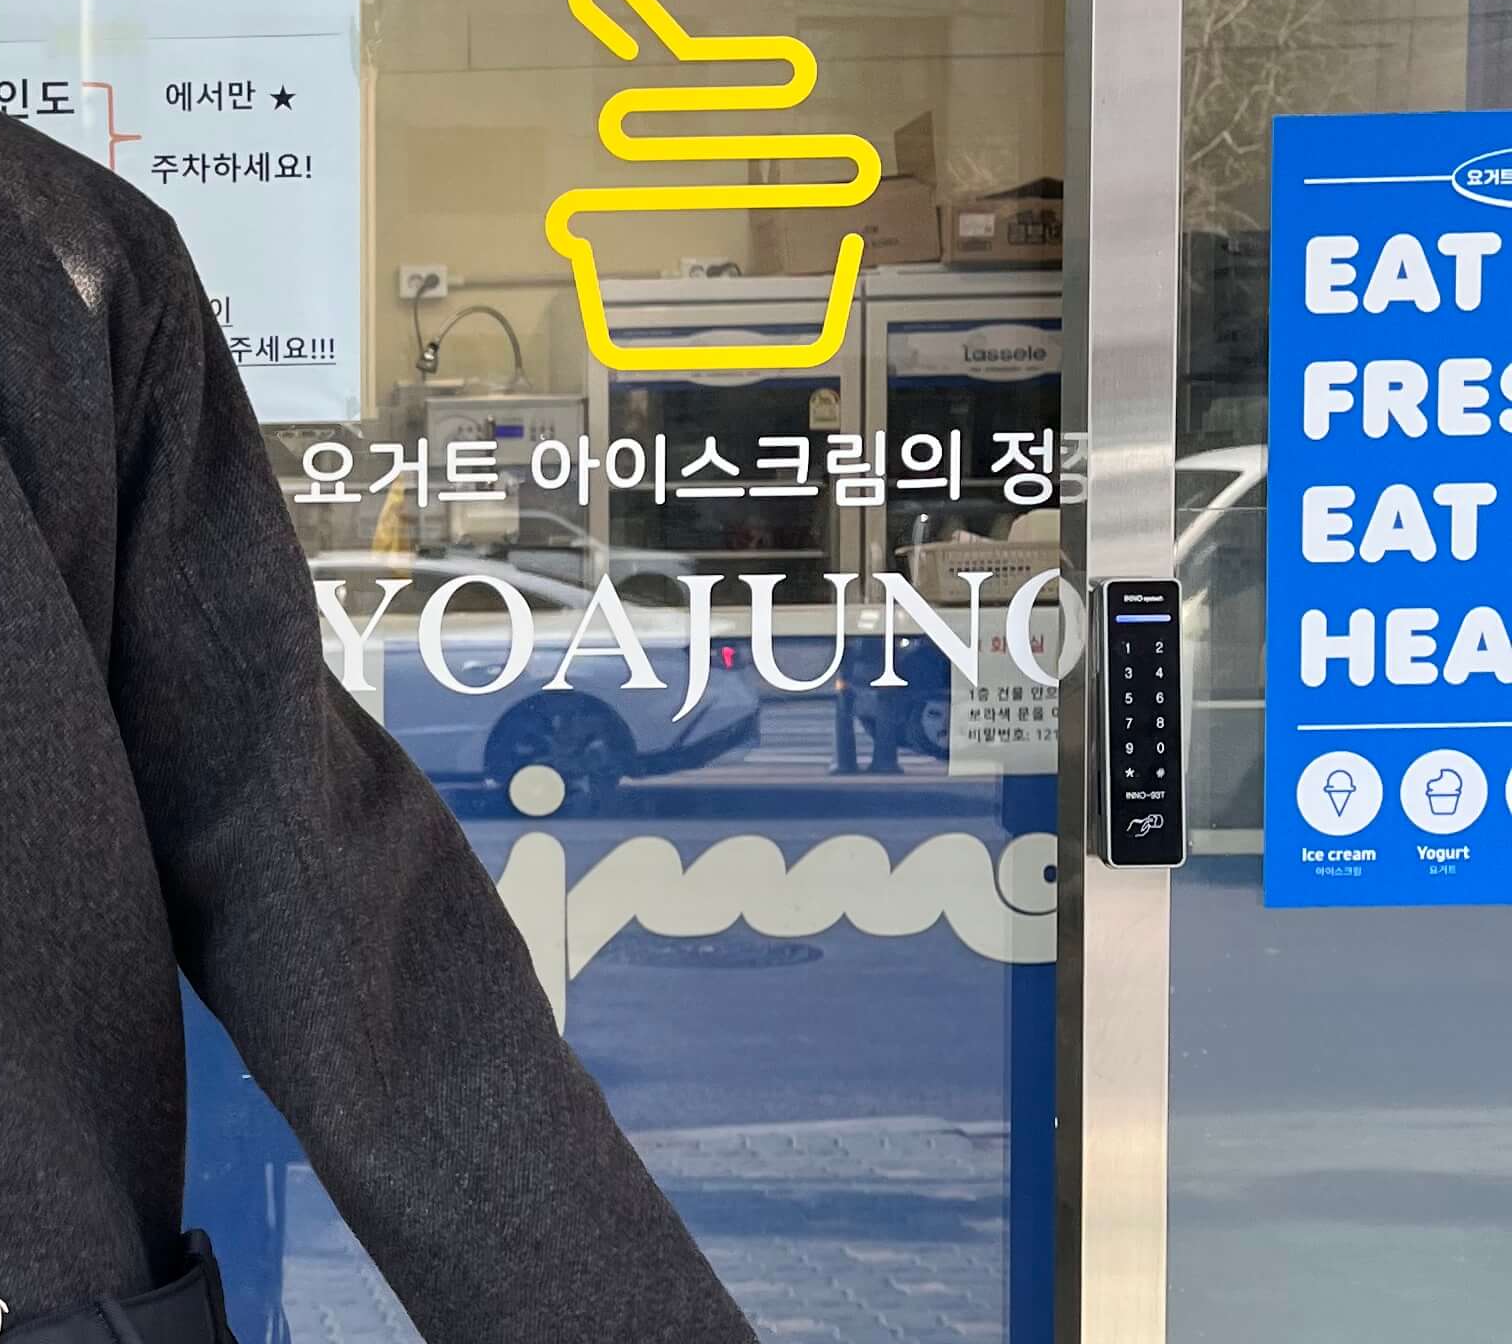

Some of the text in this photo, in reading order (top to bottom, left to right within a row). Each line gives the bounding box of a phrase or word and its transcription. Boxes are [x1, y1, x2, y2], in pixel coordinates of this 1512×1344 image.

[165, 80, 257, 112] 에서만
[150, 151, 312, 184] 주차하세요!
[1305, 232, 1502, 314] EAT
[1303, 357, 1512, 441] FRE
[293, 437, 505, 507] 요거트
[530, 428, 962, 507] 아이스크림의
[1302, 482, 1497, 563] EAT
[1125, 641, 1164, 654] 1 2
[1301, 606, 1512, 687] HEA
[1124, 667, 1164, 679] 3 4
[1125, 692, 1164, 704] 5 6
[1125, 717, 1165, 729] 7 8
[1125, 742, 1165, 754] 9 0
[1302, 847, 1376, 862] Ice cream
[1417, 845, 1471, 862] Yogurt
